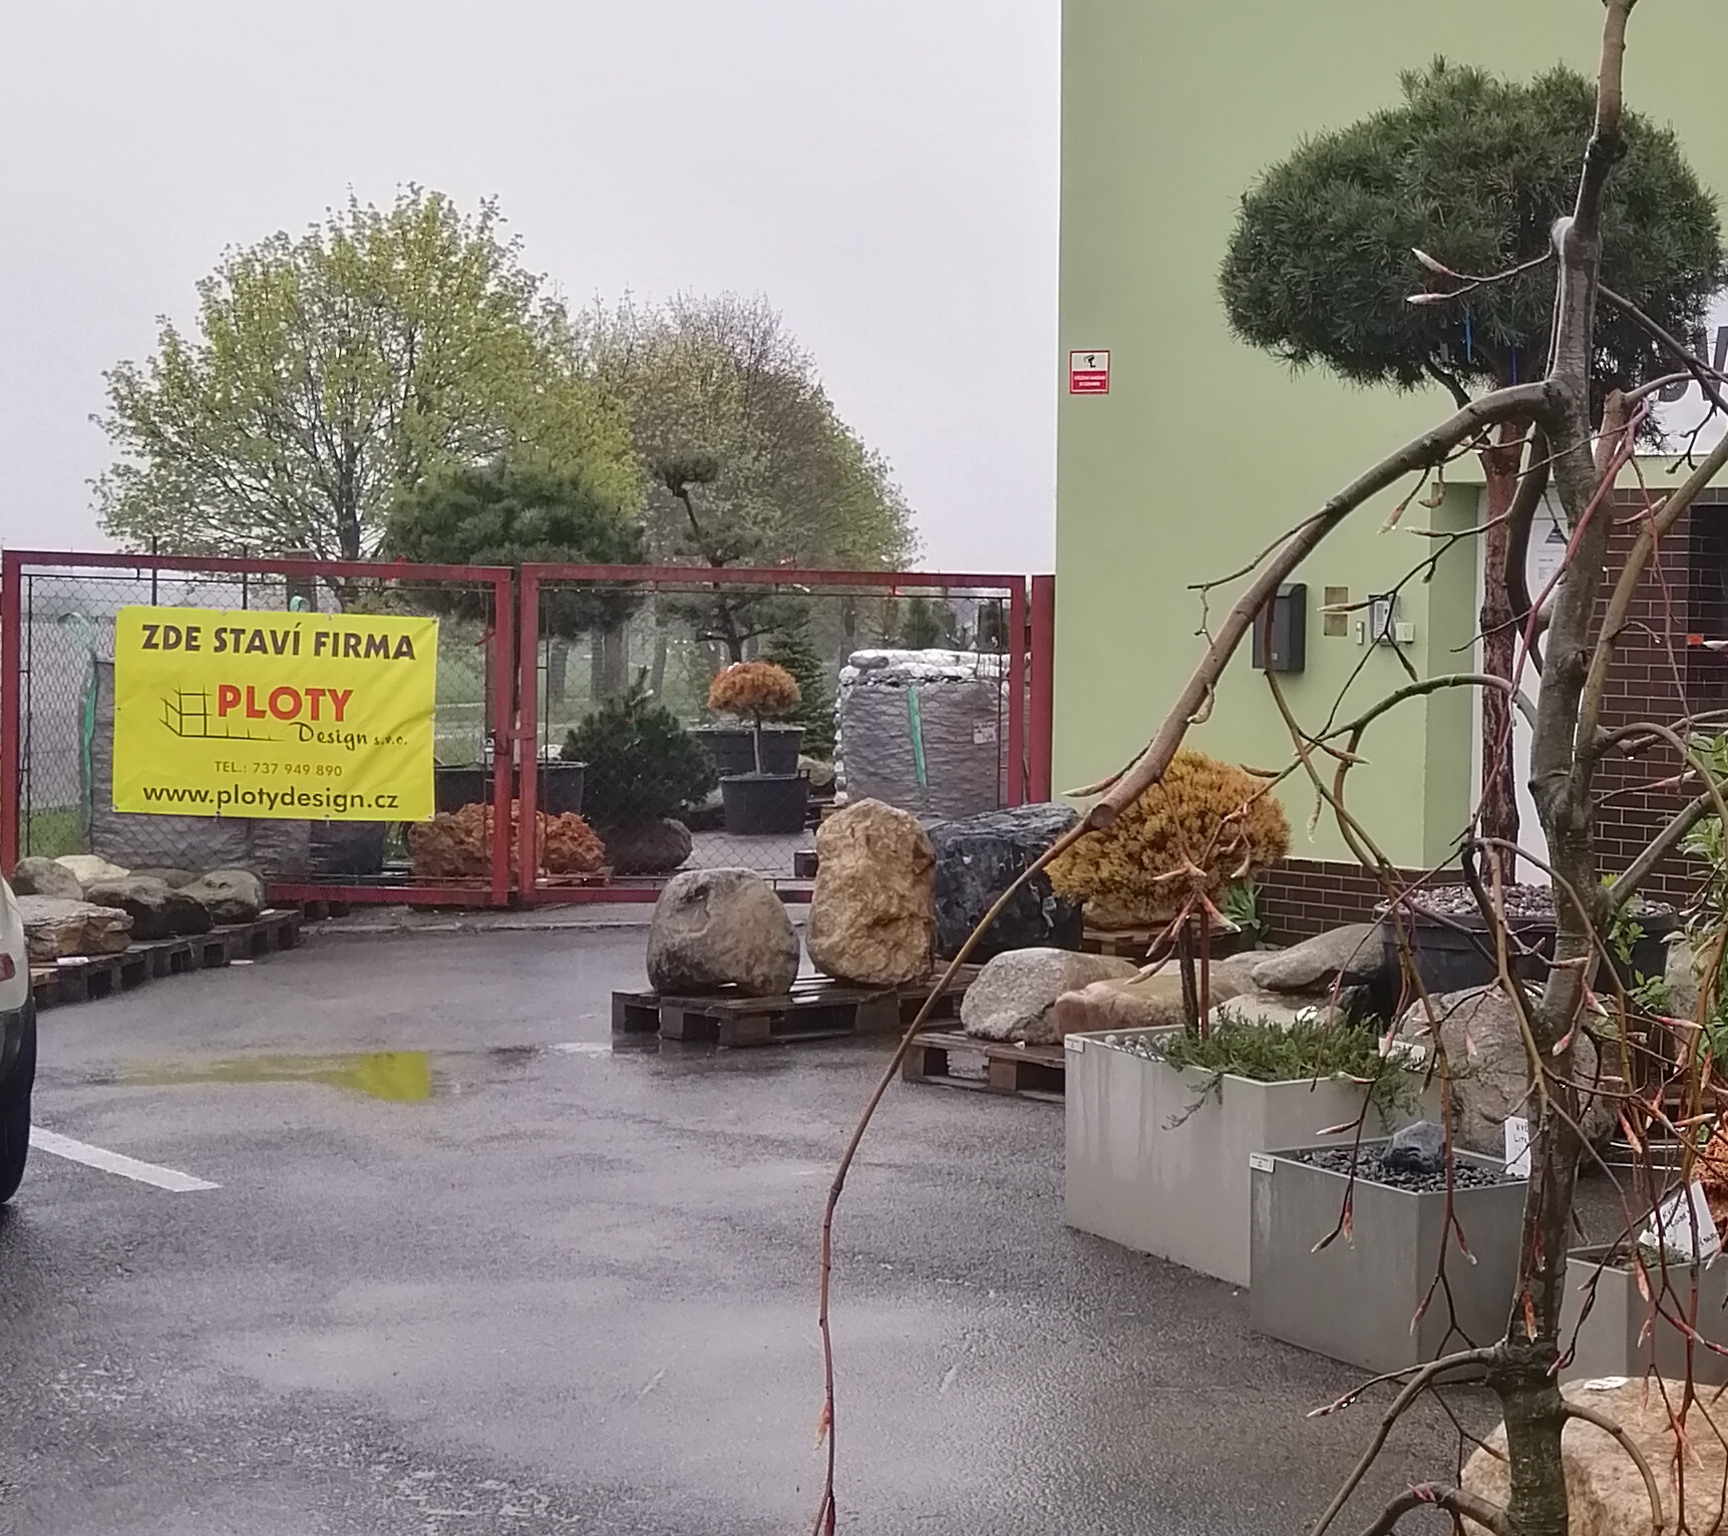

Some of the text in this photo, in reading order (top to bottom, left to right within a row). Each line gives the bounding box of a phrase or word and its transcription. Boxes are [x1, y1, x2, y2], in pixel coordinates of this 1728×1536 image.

[141, 622, 417, 661] ZDE STAVÍ FIRMA
[218, 684, 355, 723] PLOTY
[289, 721, 368, 751] Design
[214, 760, 343, 777] TEL.: 737 949 890
[142, 783, 400, 813] www.plotydesign.cz
